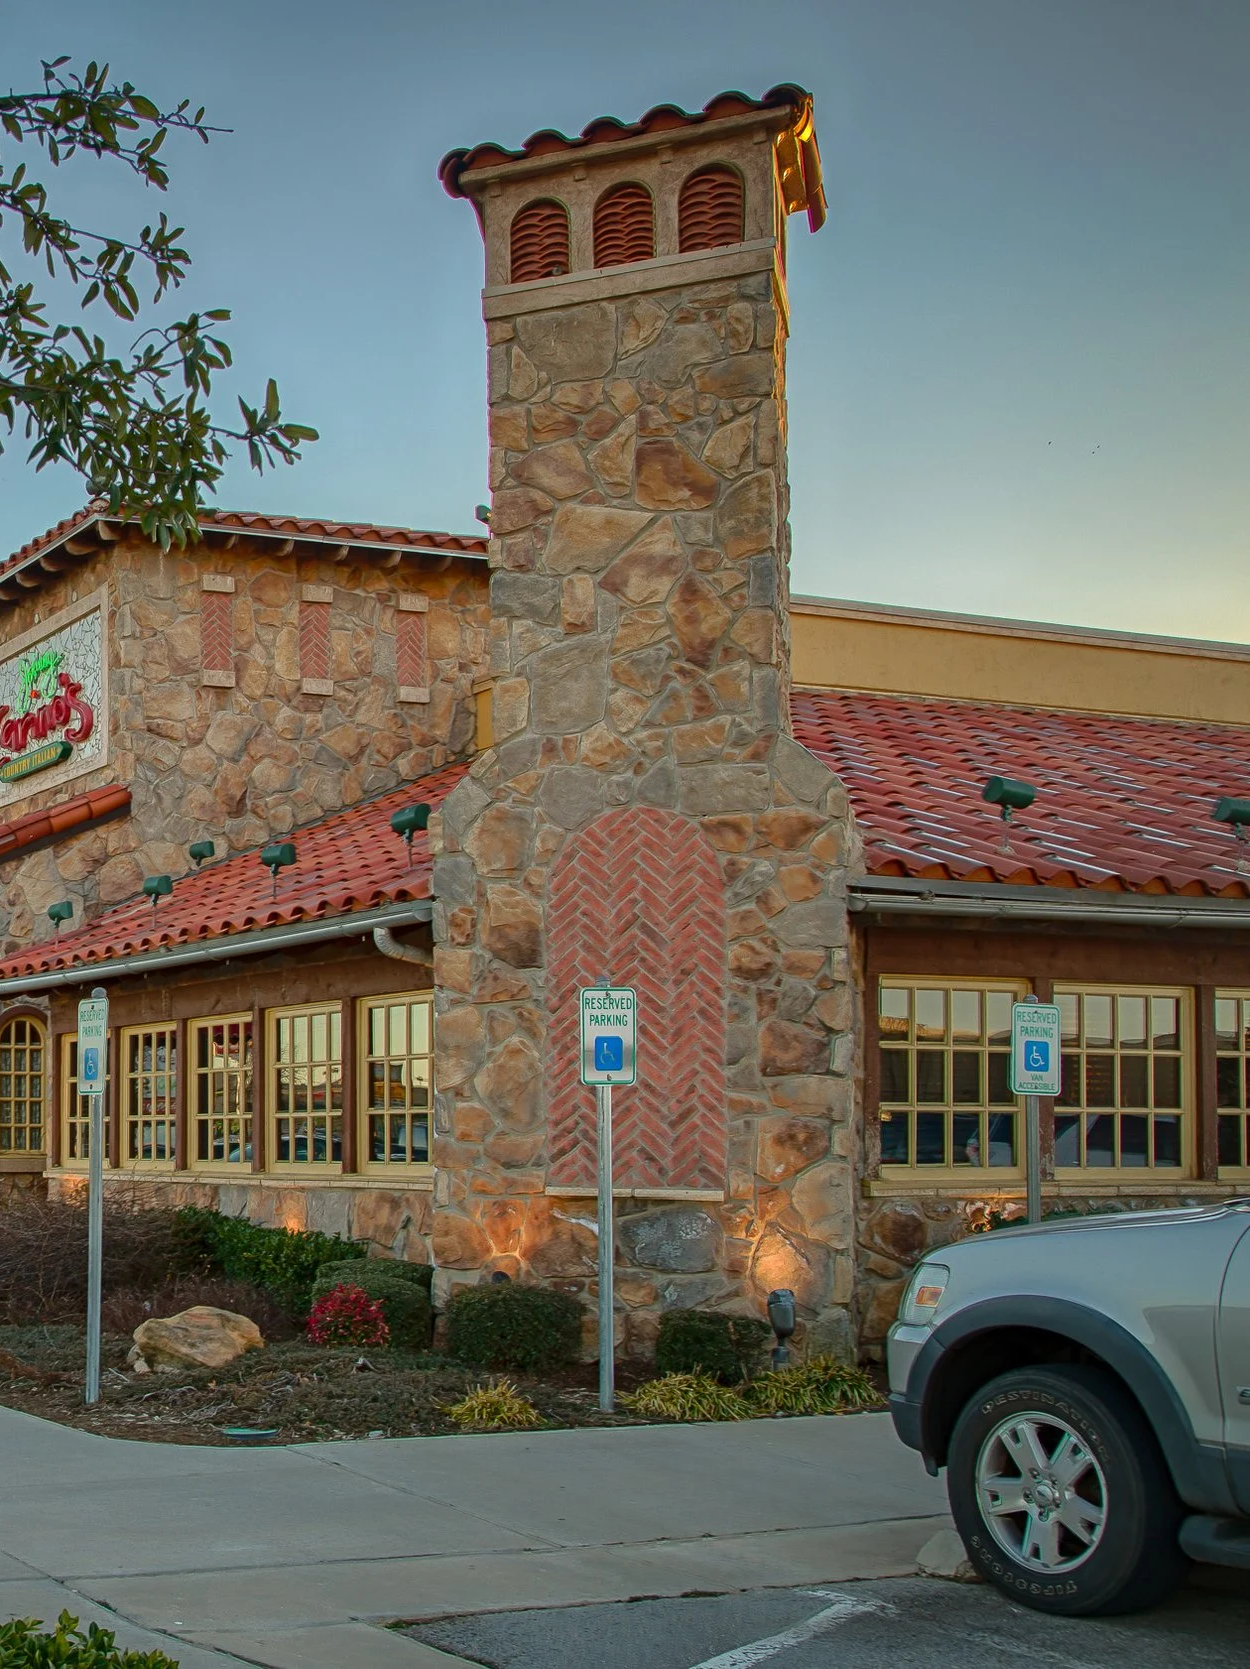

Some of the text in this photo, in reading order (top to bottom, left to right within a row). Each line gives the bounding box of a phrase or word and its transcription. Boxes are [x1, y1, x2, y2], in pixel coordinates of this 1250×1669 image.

[3, 747, 56, 779] COUNTRY ITALIAN
[585, 997, 632, 1010] RESERVED
[80, 1009, 105, 1022] RESERVED
[589, 1014, 628, 1027] PARKING
[1016, 1011, 1057, 1024] RESERVED
[82, 1025, 102, 1038] PARKING
[1020, 1026, 1054, 1039] PARKING
[1030, 1073, 1044, 1081] VAN
[1018, 1081, 1056, 1091] ACCESSIBLE
